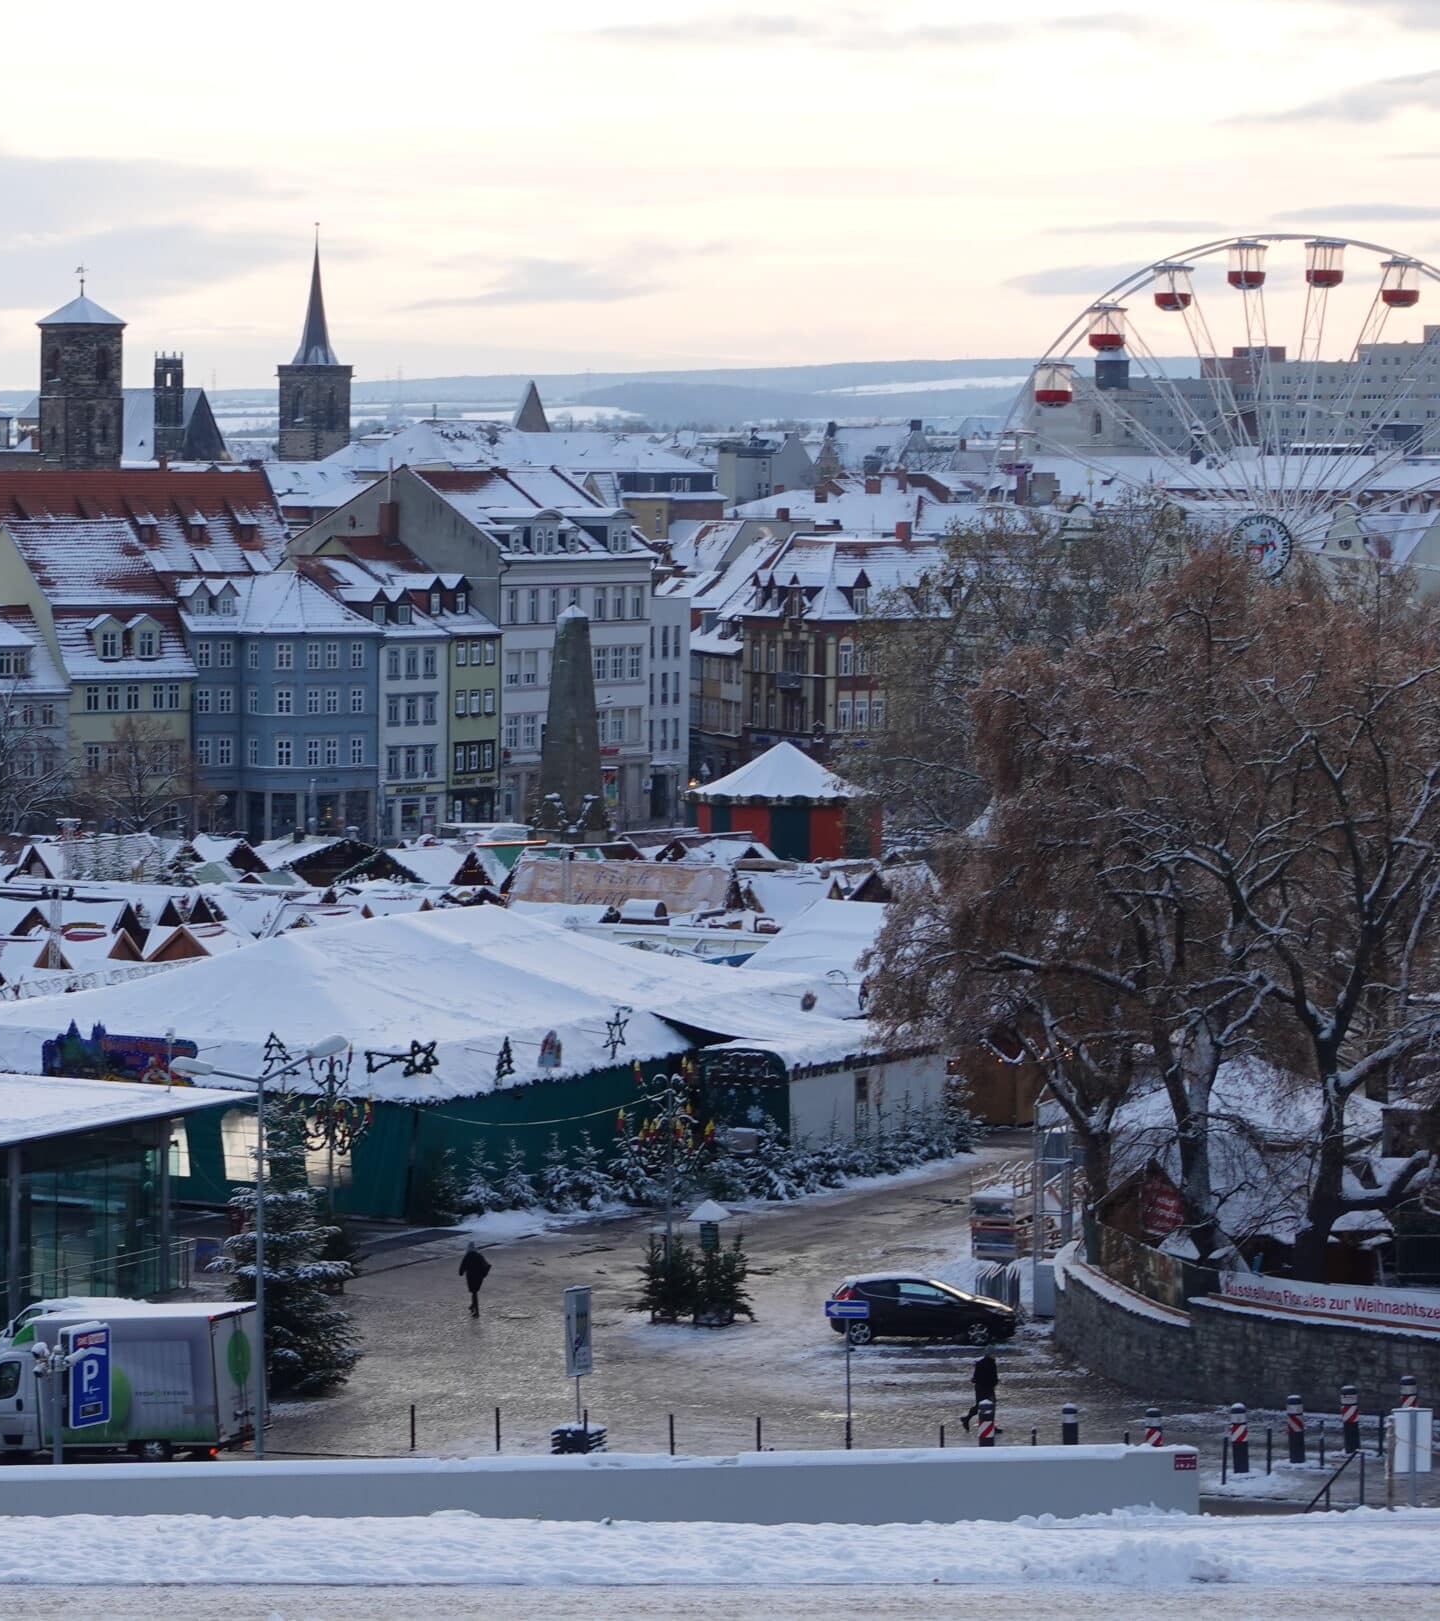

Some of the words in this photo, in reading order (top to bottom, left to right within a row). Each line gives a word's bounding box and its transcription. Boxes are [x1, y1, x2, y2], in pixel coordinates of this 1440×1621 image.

[1225, 1283, 1282, 1305] Ausstellung
[1284, 1290, 1326, 1309] Florales
[1329, 1298, 1350, 1311] zur
[83, 1359, 99, 1393] P
